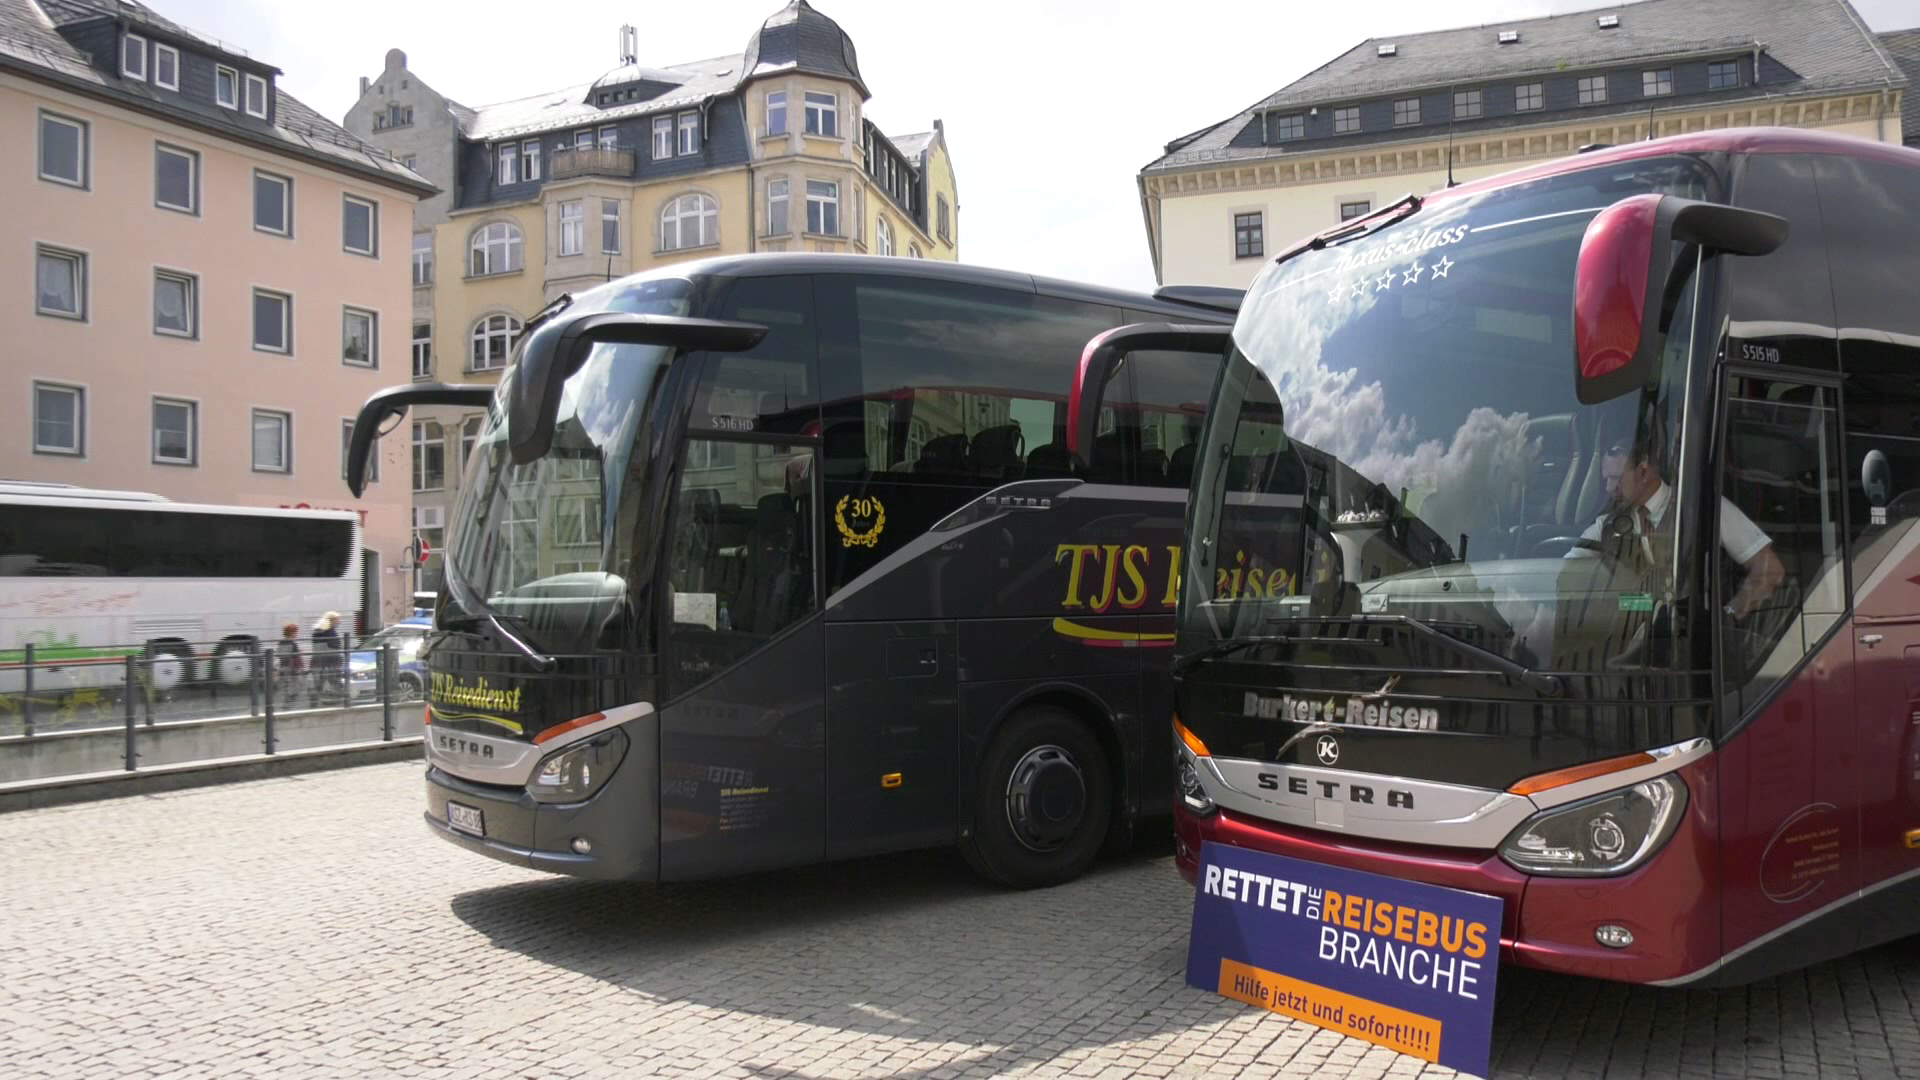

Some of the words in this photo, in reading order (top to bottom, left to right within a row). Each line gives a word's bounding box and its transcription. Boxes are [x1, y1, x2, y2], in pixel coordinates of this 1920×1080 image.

[1336, 224, 1469, 275] luxus-class
[1742, 344, 1750, 360] S
[1749, 345, 1765, 361] 515
[1765, 347, 1779, 363] HD
[712, 416, 719, 429] S
[720, 417, 737, 430] 516
[739, 419, 754, 431] HD
[851, 498, 872, 518] 30
[985, 496, 1051, 507] SETRA
[1055, 543, 1150, 613] TJS
[444, 674, 521, 712] Reisedienst
[1243, 691, 1439, 731] Burkert-Reisen
[440, 735, 494, 759] SETRA
[1257, 772, 1414, 810] SETRA
[1204, 864, 1307, 916] RETTET
[1306, 885, 1322, 920] DIE
[1323, 889, 1488, 959] REISEBUS
[1318, 926, 1481, 1000] BRANCHE
[1233, 973, 1269, 1001] Hilfe
[1272, 985, 1308, 1014] jetzt
[1312, 1001, 1344, 1025] und
[1347, 1012, 1431, 1052] sofort!!!!
